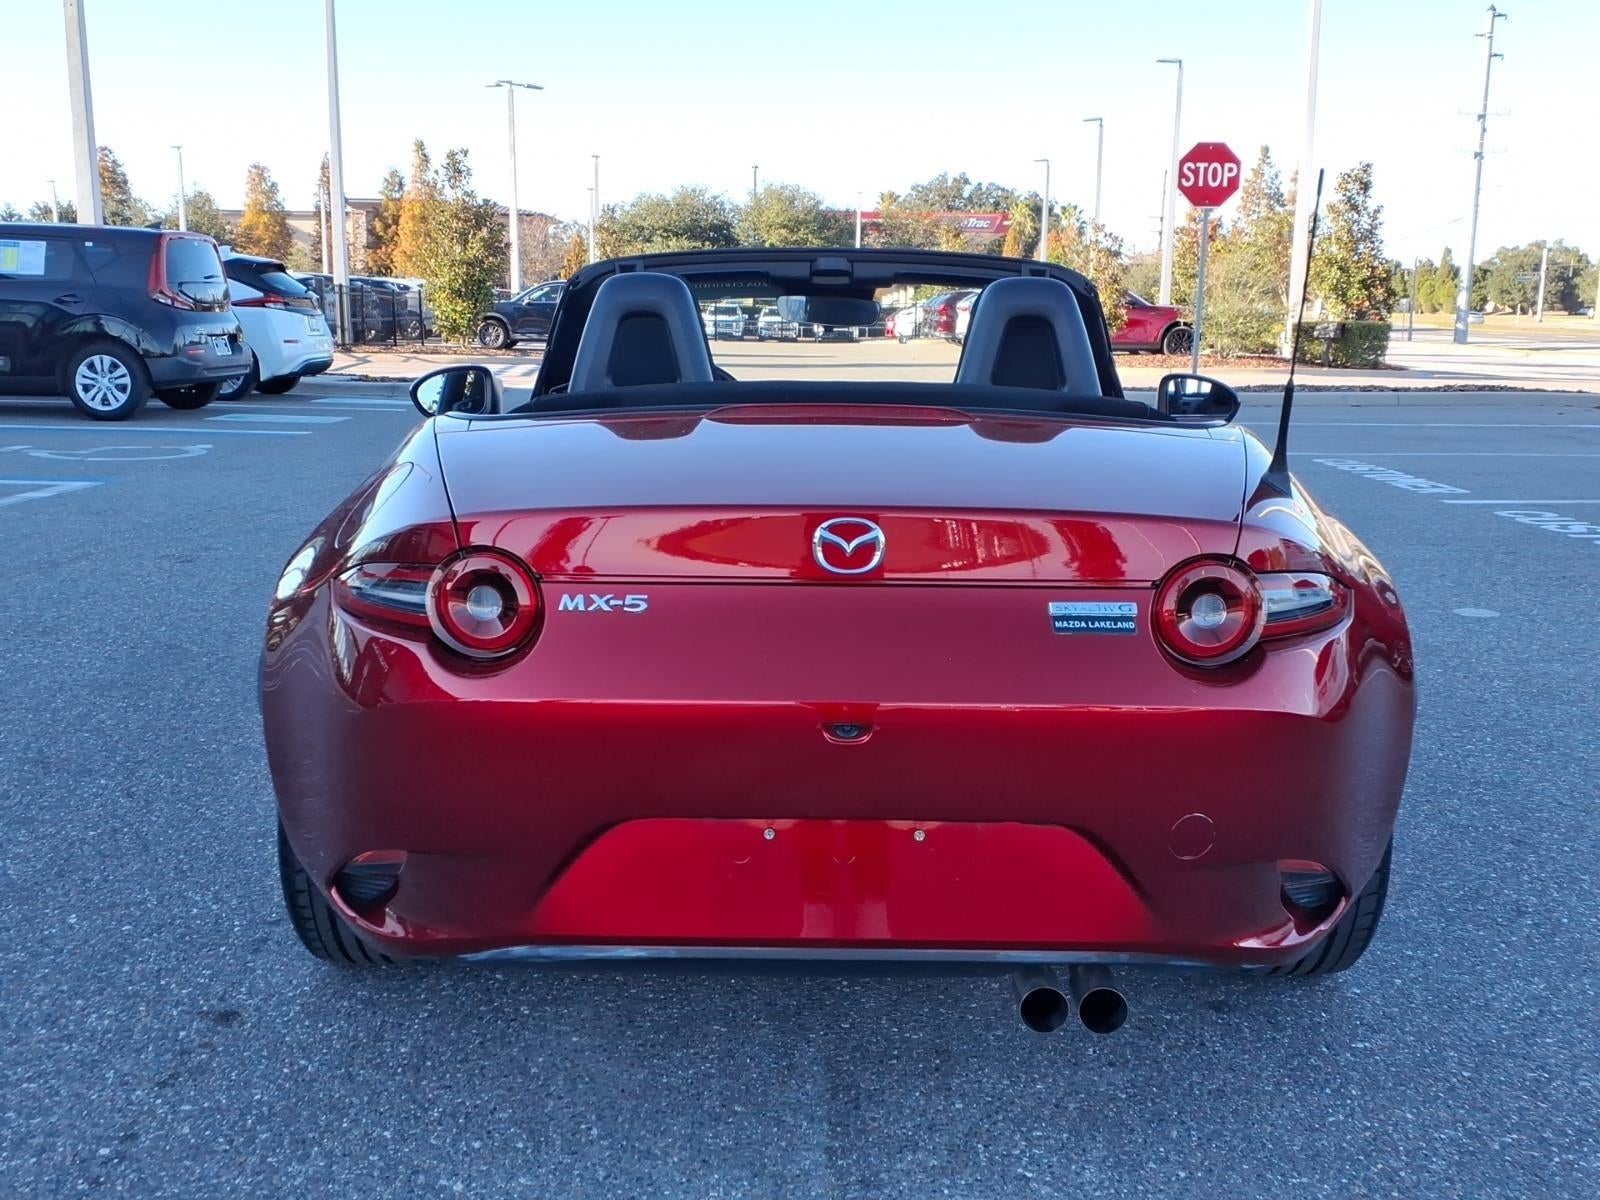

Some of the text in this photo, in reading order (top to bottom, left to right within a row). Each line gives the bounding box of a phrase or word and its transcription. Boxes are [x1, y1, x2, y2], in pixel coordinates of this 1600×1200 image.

[1181, 161, 1238, 188] STOP
[557, 593, 648, 611] MX-5
[1055, 620, 1135, 629] MAZDA LAKELAND
